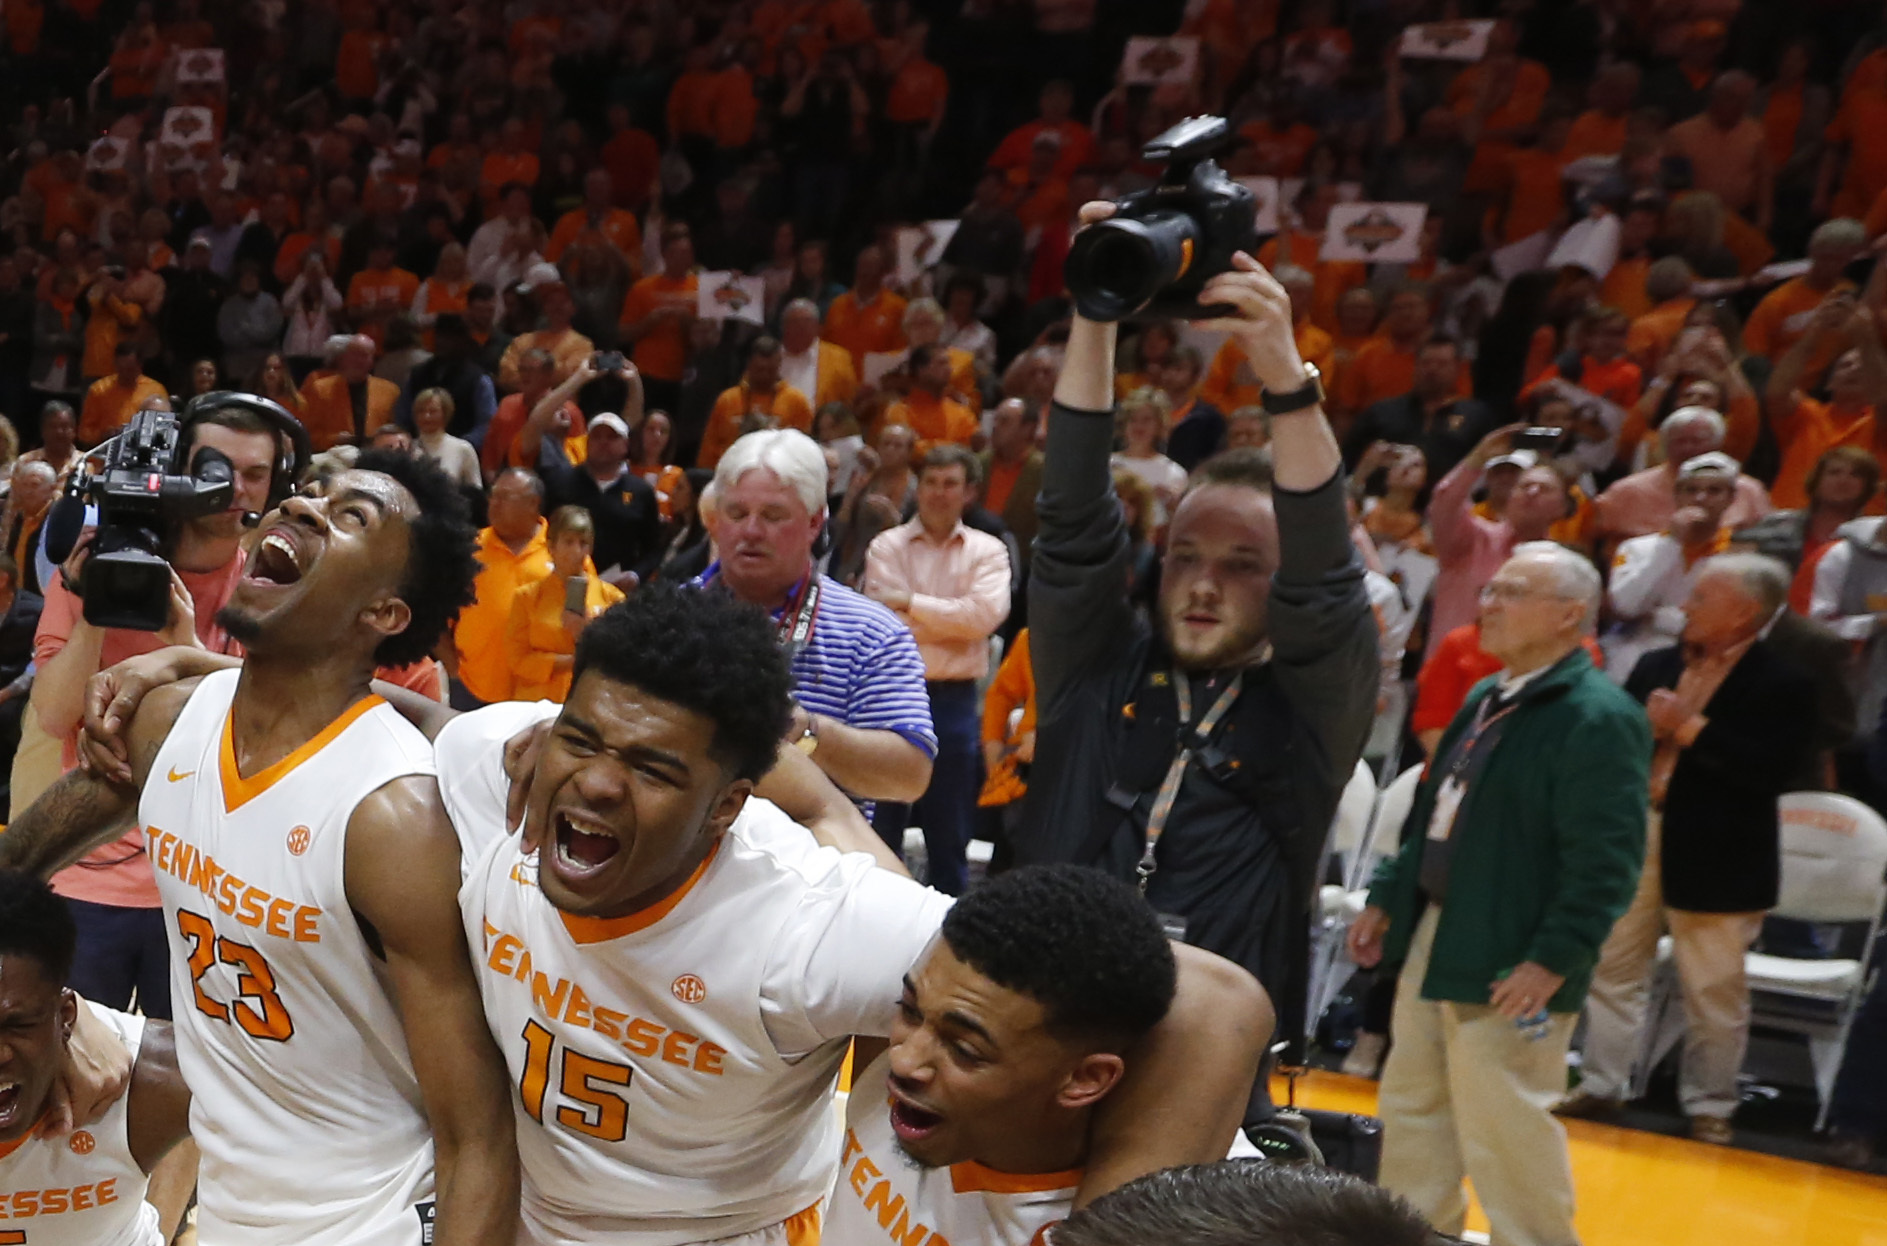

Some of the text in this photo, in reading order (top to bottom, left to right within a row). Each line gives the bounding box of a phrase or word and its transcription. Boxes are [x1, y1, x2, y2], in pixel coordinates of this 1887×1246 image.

[146, 825, 323, 943] TENNESSEE
[177, 907, 295, 1042] 23
[671, 973, 706, 1004] SEC
[520, 1017, 634, 1142] 15
